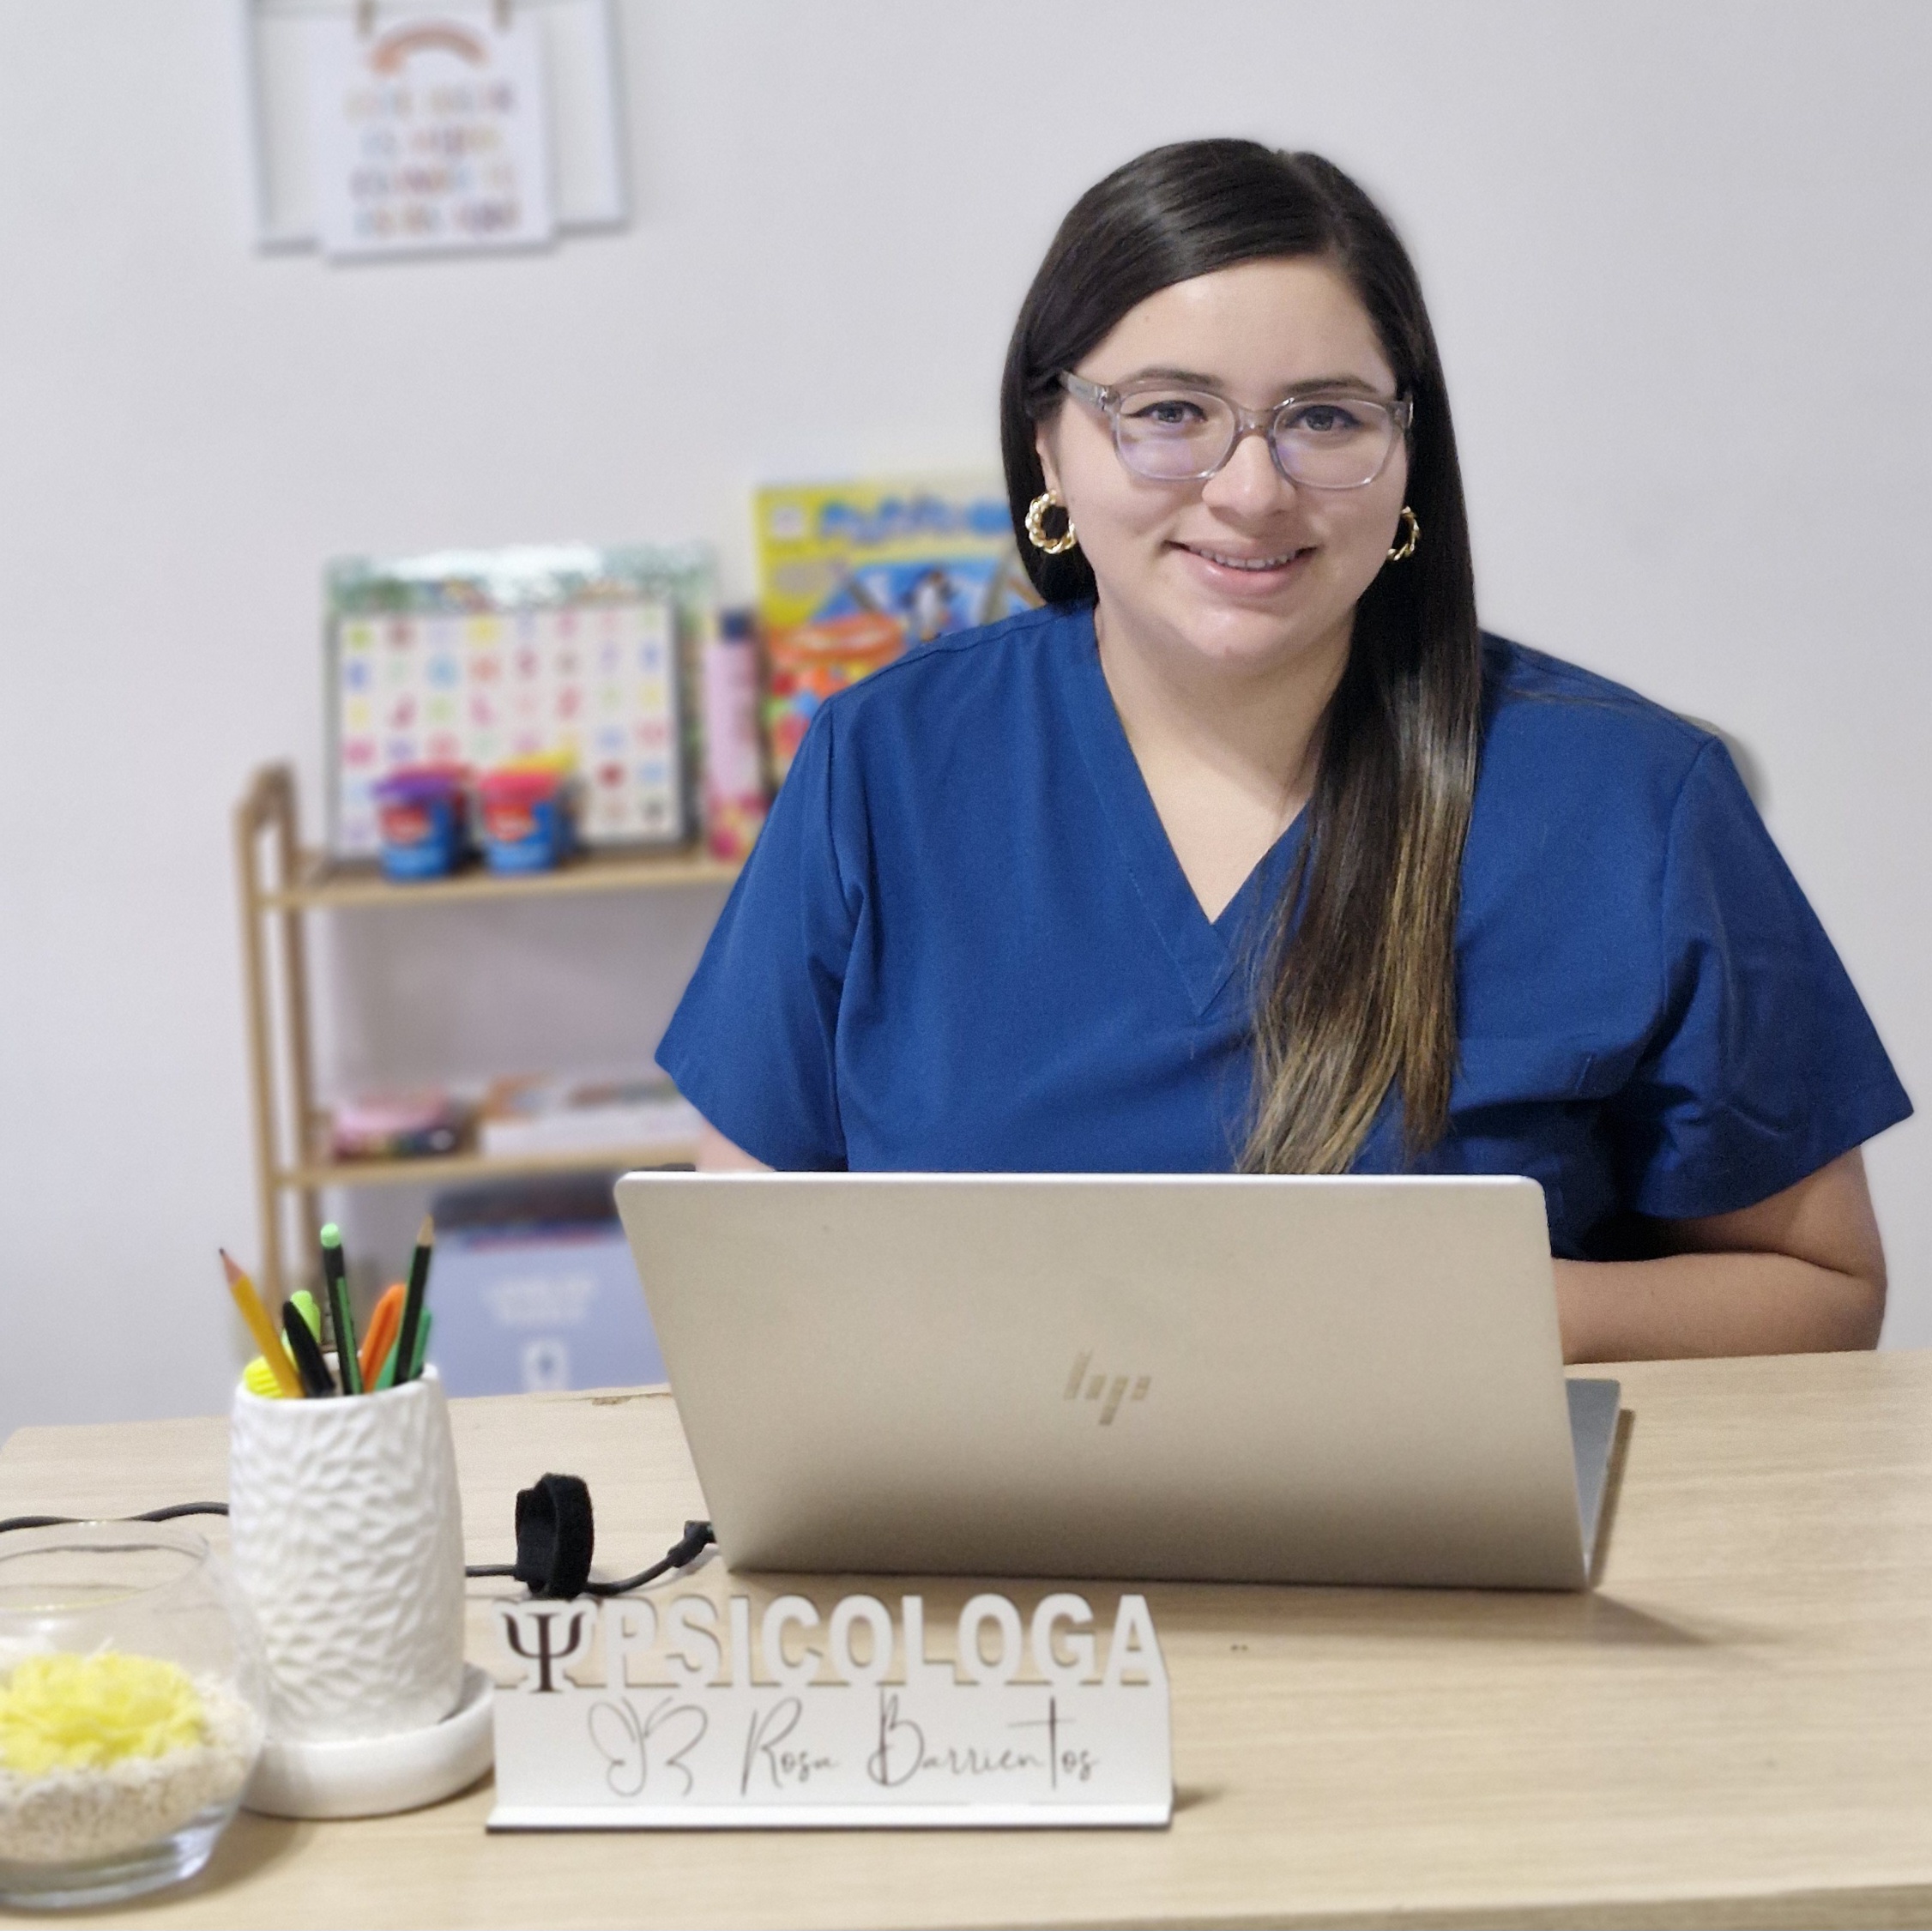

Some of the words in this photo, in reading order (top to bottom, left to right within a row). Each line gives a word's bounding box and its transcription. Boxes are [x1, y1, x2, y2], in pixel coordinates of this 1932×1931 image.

[1062, 1347, 1152, 1427] hp
[604, 1593, 1168, 1688] PSICOLOGA
[740, 1696, 840, 1797] Rosa
[866, 1687, 1100, 1791] Barrientos
